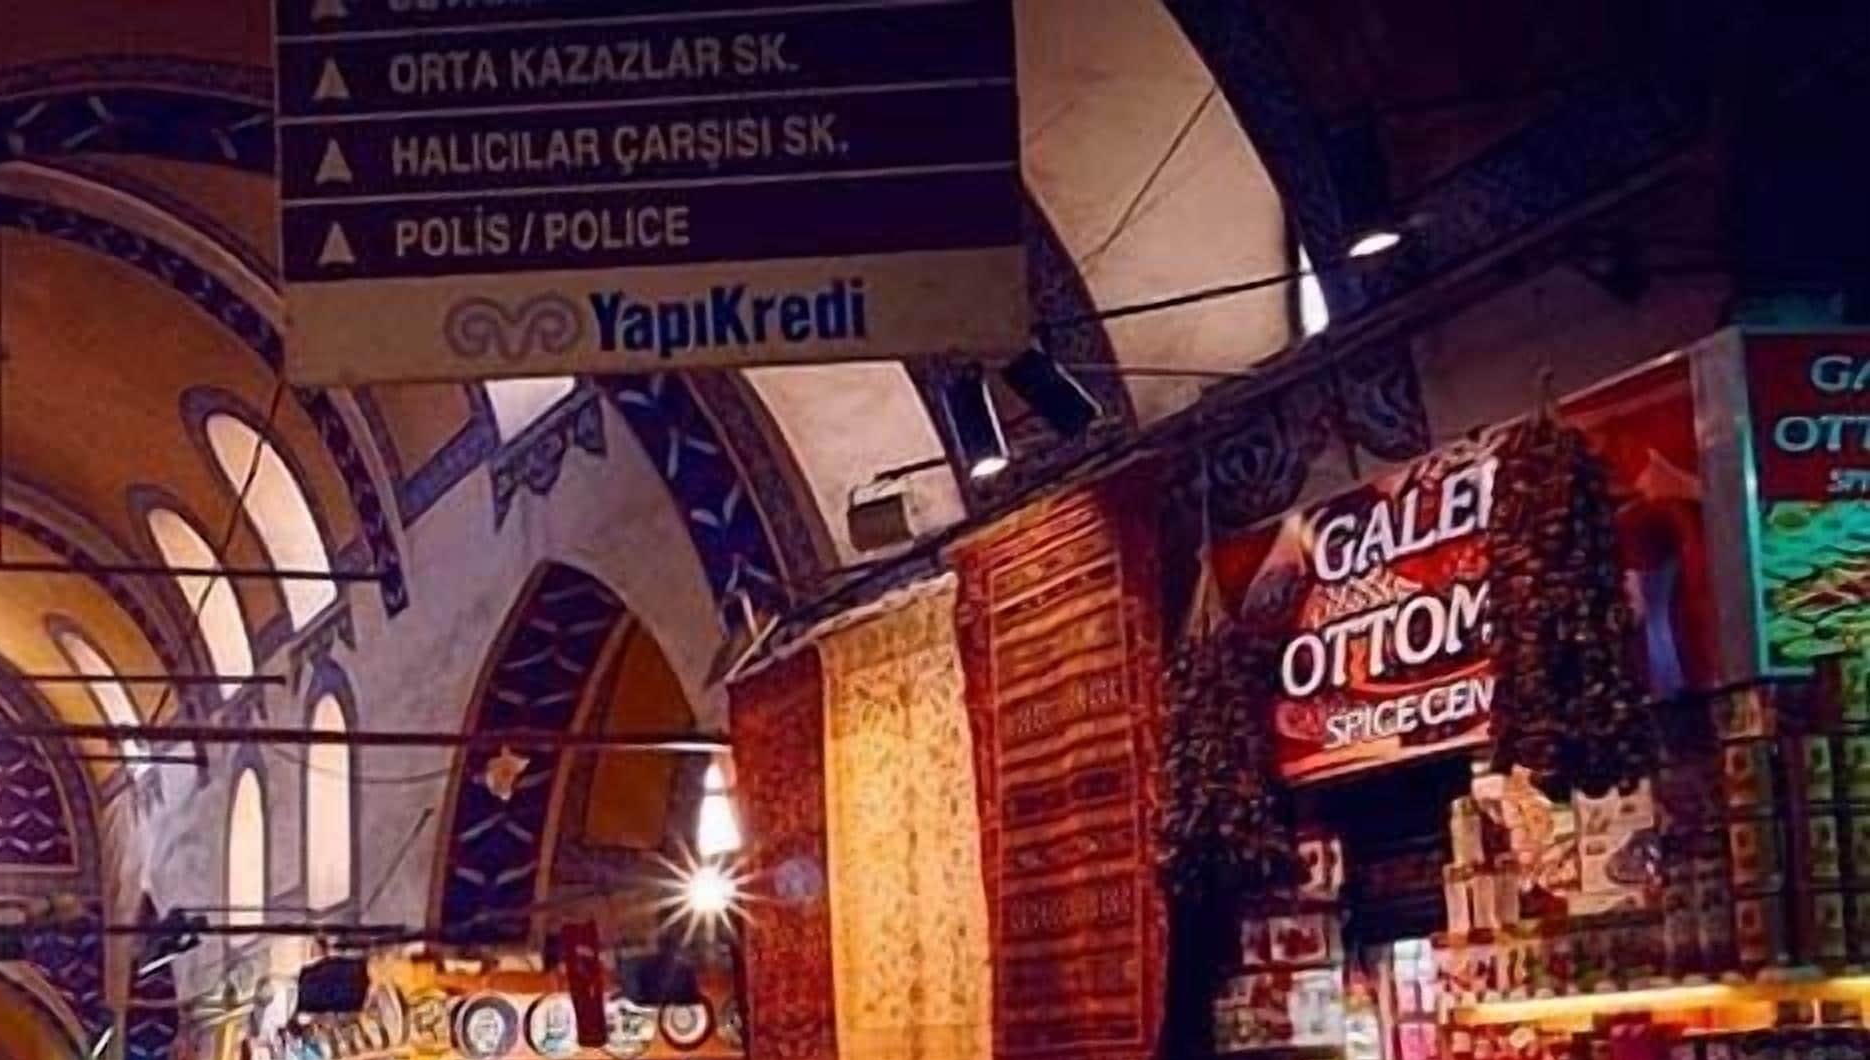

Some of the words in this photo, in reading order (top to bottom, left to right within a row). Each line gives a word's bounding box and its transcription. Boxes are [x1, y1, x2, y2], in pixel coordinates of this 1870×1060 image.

[388, 49, 499, 95] ORTA
[510, 36, 722, 89] KAZAZLAR
[733, 33, 801, 76] SK.
[391, 127, 602, 177] HALICILAR
[611, 117, 772, 175] ÇARŞISI
[783, 112, 849, 156] SK.
[394, 204, 511, 257] POLİS
[518, 211, 535, 254] /
[544, 206, 692, 252] POLICE
[588, 276, 868, 359] YapıKredi
